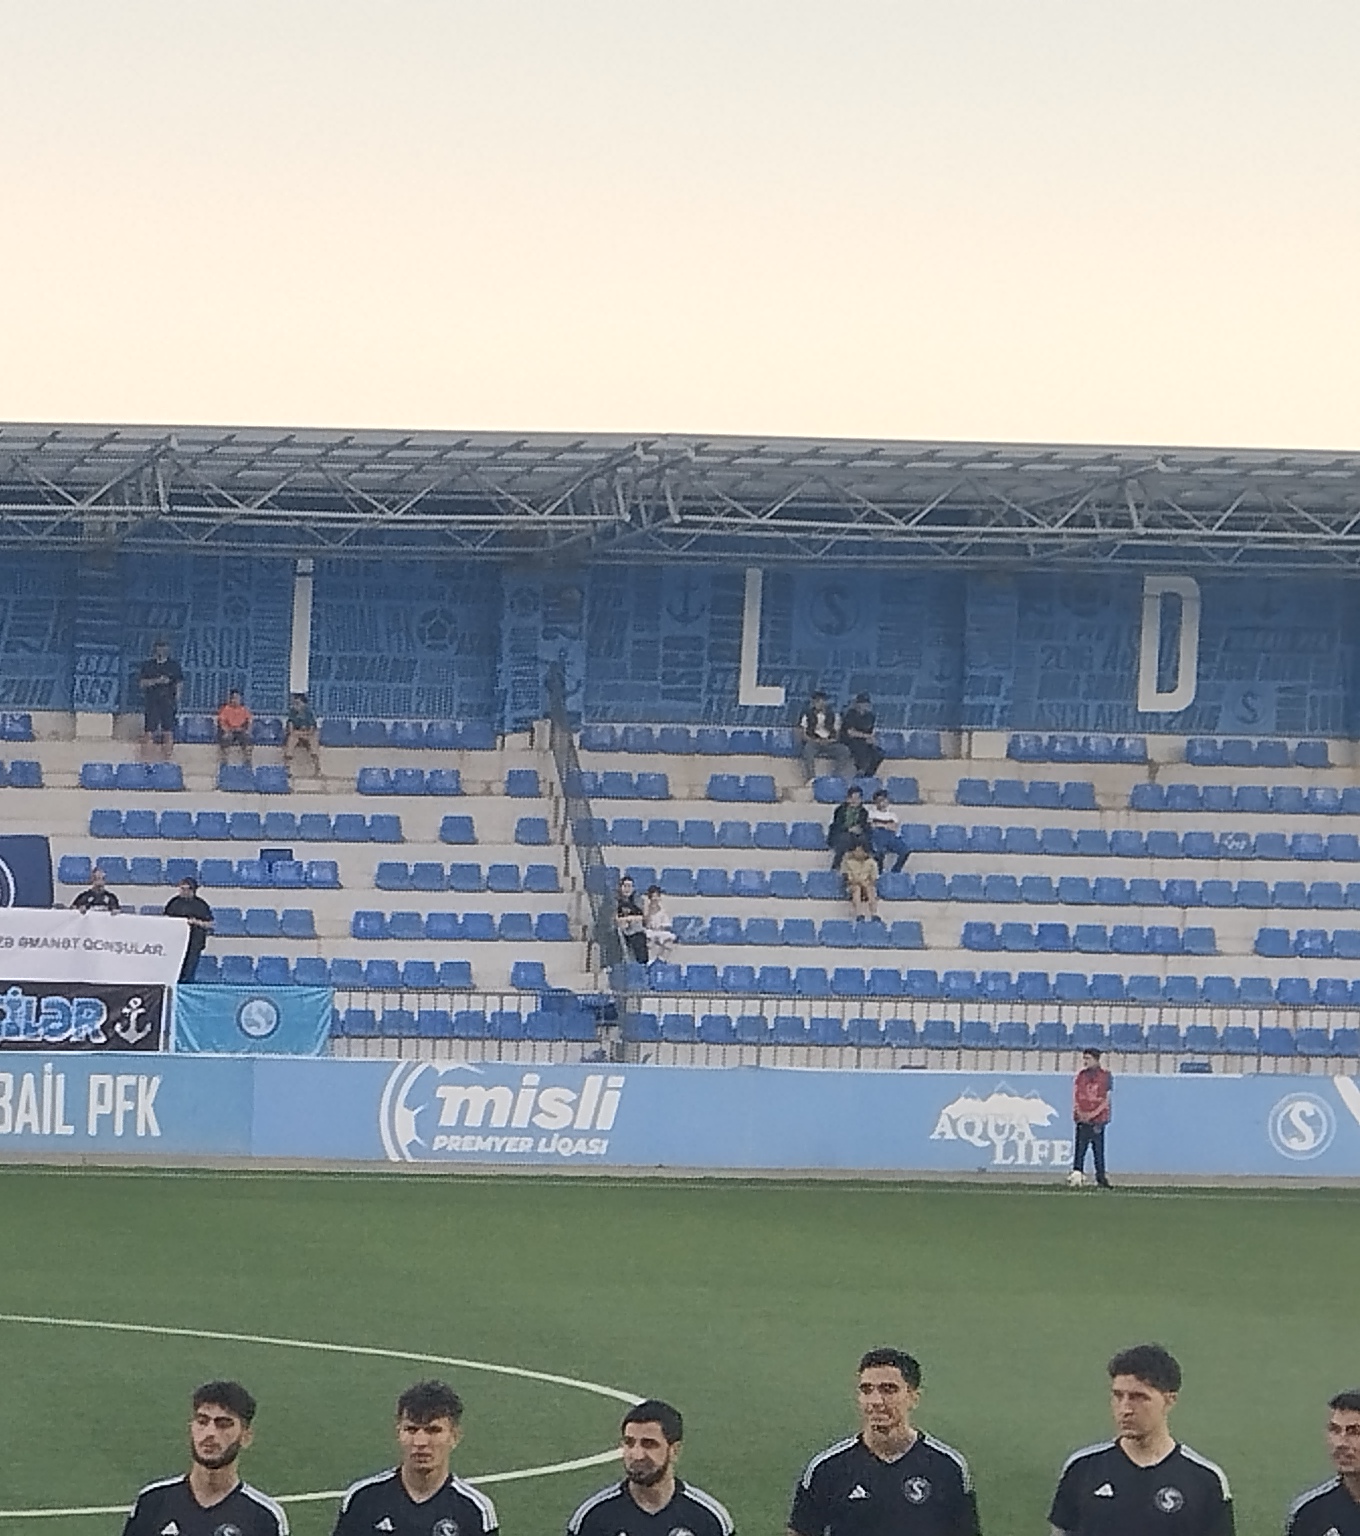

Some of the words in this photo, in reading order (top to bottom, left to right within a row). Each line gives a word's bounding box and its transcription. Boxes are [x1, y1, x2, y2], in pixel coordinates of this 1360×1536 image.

[87, 1074, 162, 1137] PFK
[436, 1073, 625, 1131] misli
[929, 1112, 1037, 1147] AQUA
[992, 1140, 1074, 1165] LIFE
